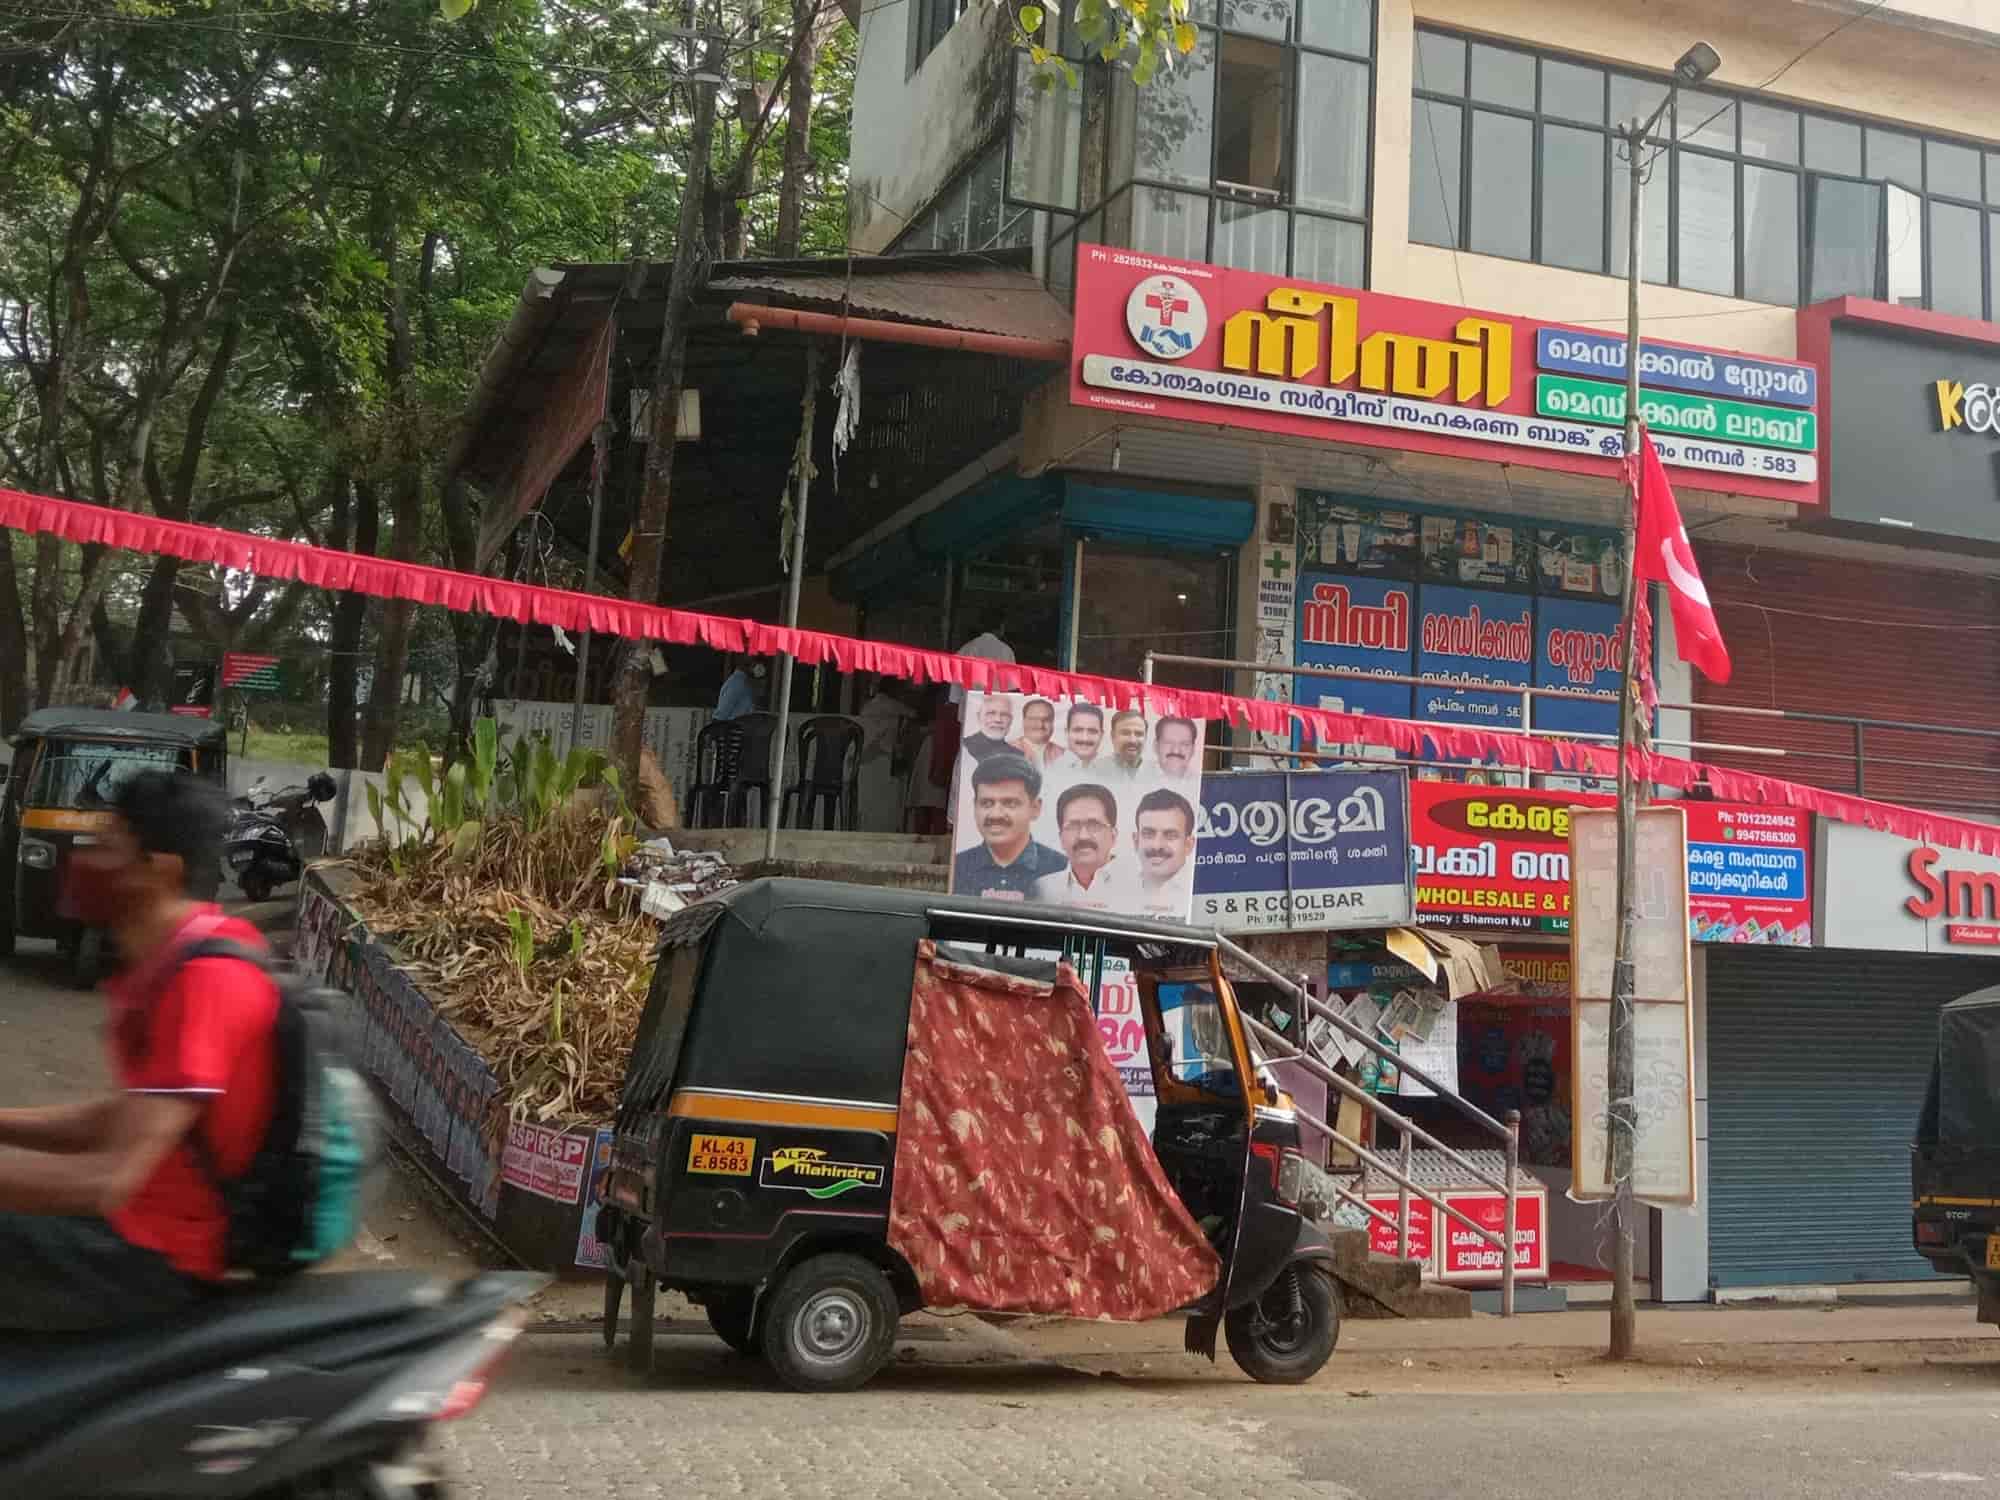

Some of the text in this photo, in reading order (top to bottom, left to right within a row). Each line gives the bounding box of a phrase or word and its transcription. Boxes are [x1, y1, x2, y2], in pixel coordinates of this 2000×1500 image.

[1223, 287, 1512, 408] നീതി
[1548, 338, 1808, 398] മെഡക്കൽ സ്റ്റോർ
[1111, 365, 1271, 403] കോതമംഗലം
[1280, 390, 1387, 418] സർവ്വീസ്
[1393, 404, 1519, 437] സഹകരണ
[1527, 422, 1593, 448] ബാങ്ക്
[1684, 446, 1745, 467] നമ്പർ
[1762, 455, 1797, 473] 583
[1547, 388, 1808, 445] മെഡക്കൽ ലാബ്
[1302, 582, 1409, 653] നീതി
[1423, 604, 1531, 663] മെഡിക്കൽ
[1728, 851, 1797, 870] സംസ്ഥാന
[1205, 892, 1364, 915] S & R COOLBAR
[1416, 887, 1536, 910] WHOLESALE
[1543, 894, 1556, 911] &
[1462, 914, 1510, 926] Shamon
[1511, 915, 1531, 928] N.U
[700, 1137, 746, 1156] KL.43
[775, 1149, 818, 1161] ALFA
[691, 1155, 749, 1172] E.8583
[793, 1161, 876, 1181] Mahindra
